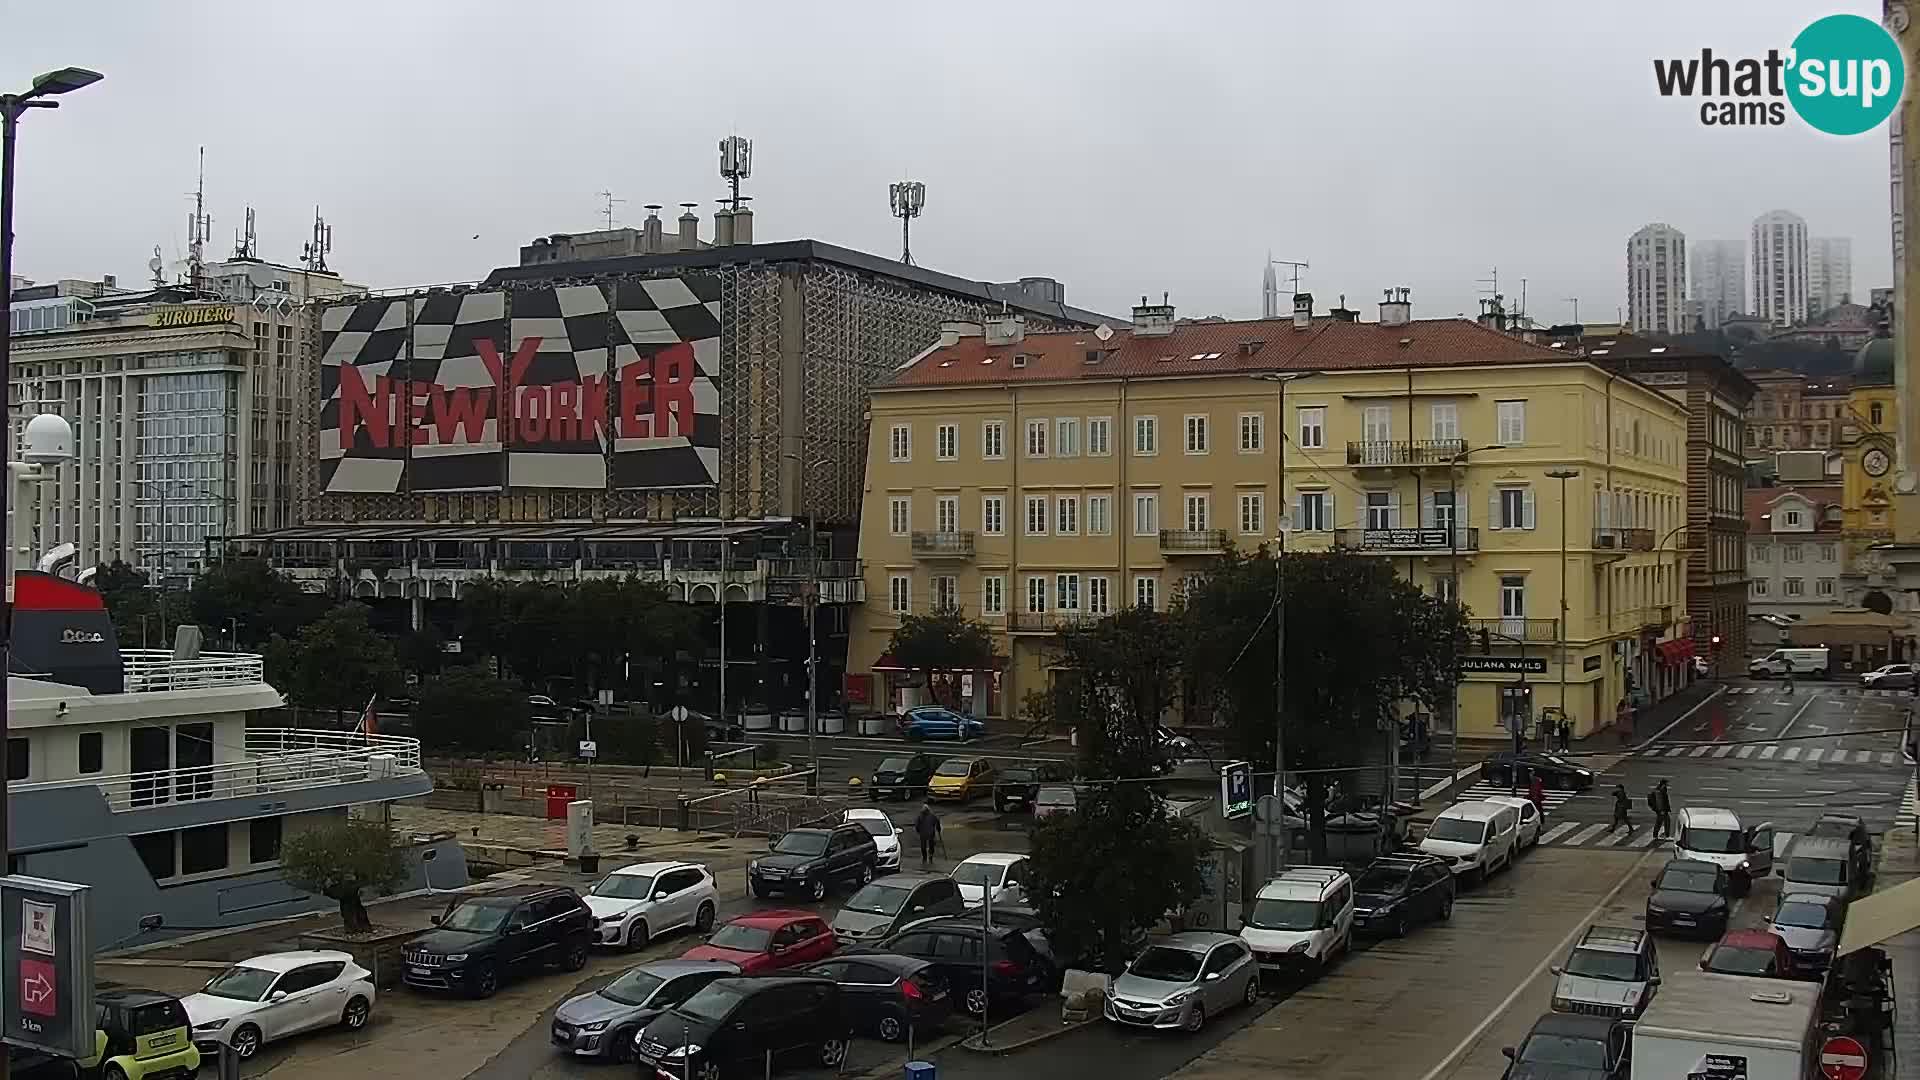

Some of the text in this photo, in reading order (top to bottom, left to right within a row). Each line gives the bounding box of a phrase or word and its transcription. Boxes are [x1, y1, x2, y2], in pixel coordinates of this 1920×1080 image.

[1461, 660, 1506, 670] JULIANA
[22, 1018, 42, 1033] 5 km
